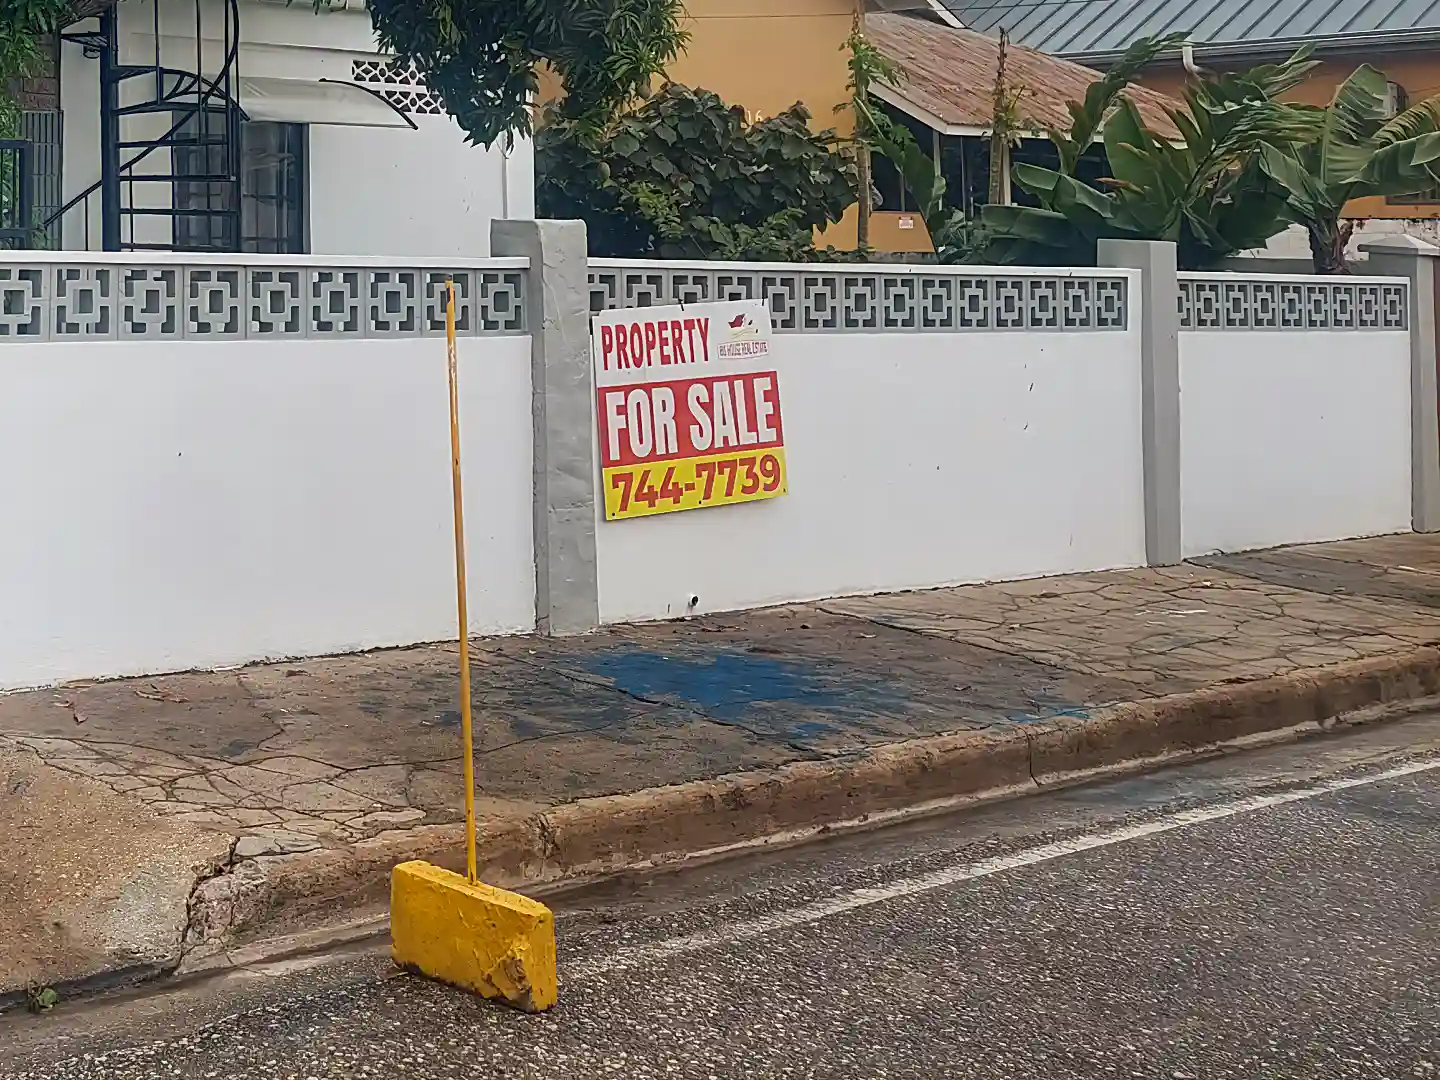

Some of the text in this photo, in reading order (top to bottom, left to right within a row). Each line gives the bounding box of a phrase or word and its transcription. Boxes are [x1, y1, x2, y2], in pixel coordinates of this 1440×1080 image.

[600, 317, 710, 371] PROPERTY
[605, 376, 777, 461] FOR SALE
[611, 454, 780, 512] 744-7739
